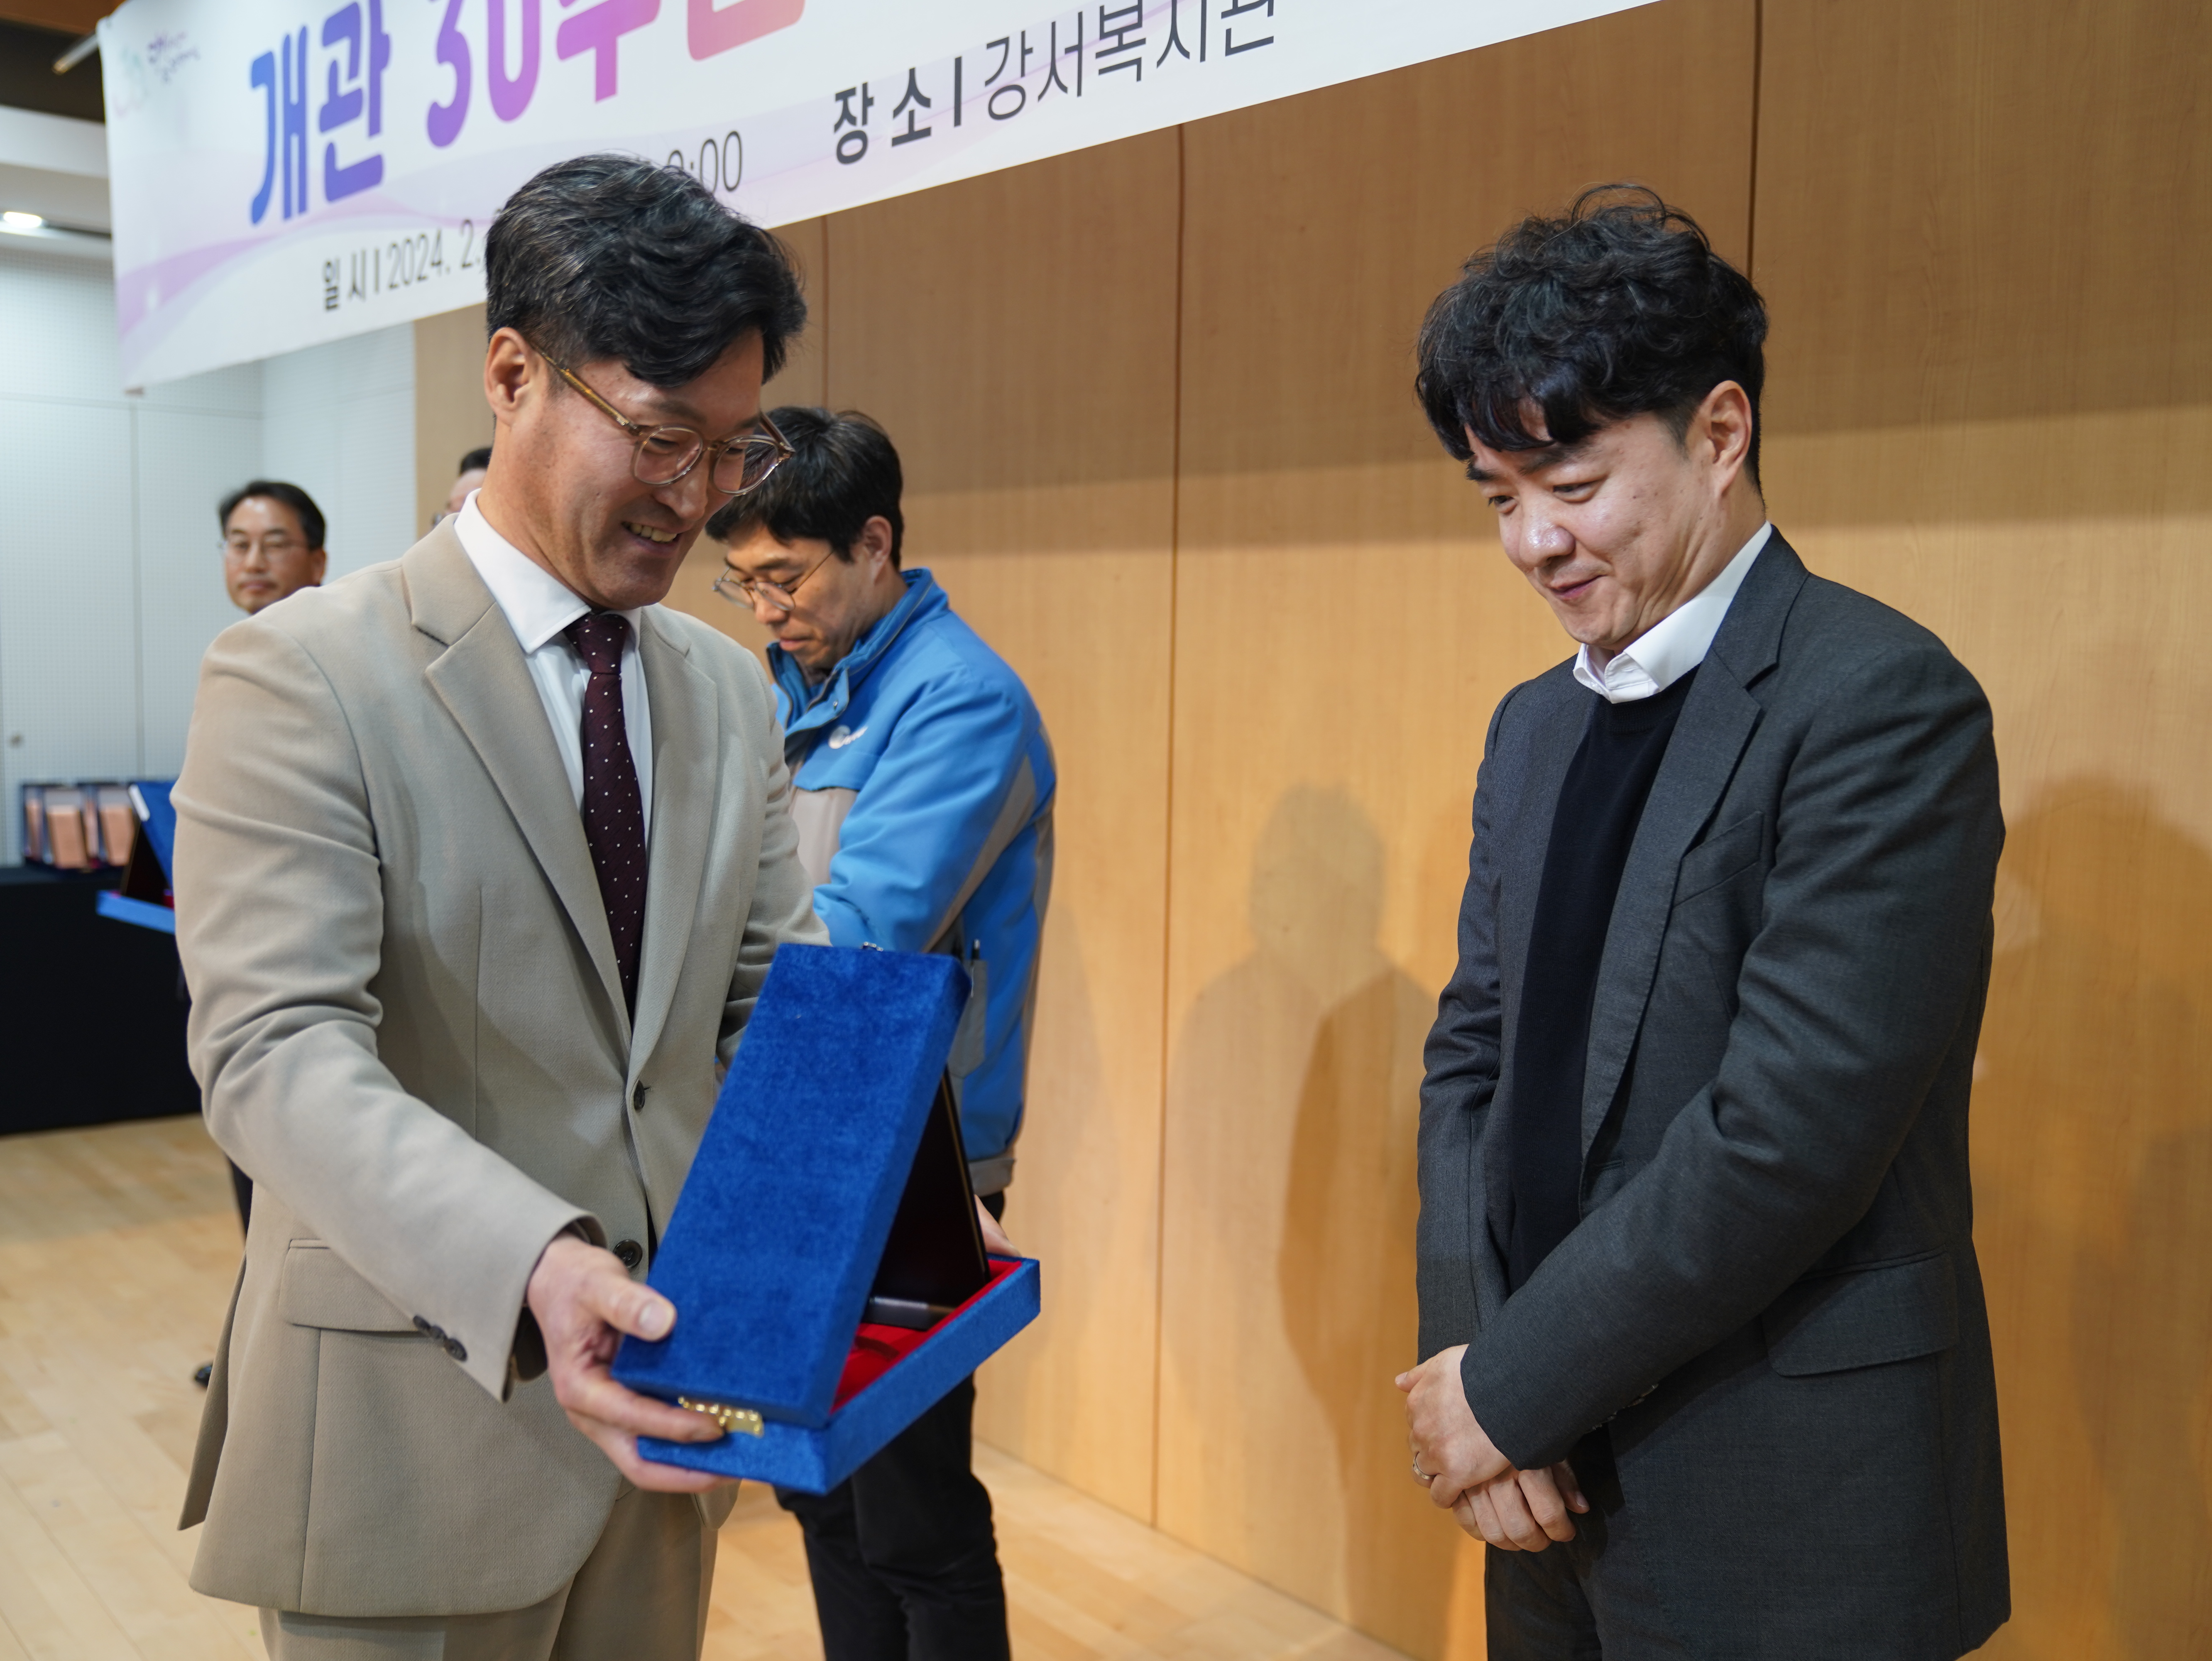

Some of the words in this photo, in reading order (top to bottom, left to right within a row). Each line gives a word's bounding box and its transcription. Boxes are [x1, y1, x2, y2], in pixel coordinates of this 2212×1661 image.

[250, 0, 389, 225] 개관
[834, 81, 874, 165] 장
[891, 66, 931, 147] 소
[323, 256, 340, 311] 일
[348, 249, 366, 301] 시
[386, 228, 450, 289] 2024.
